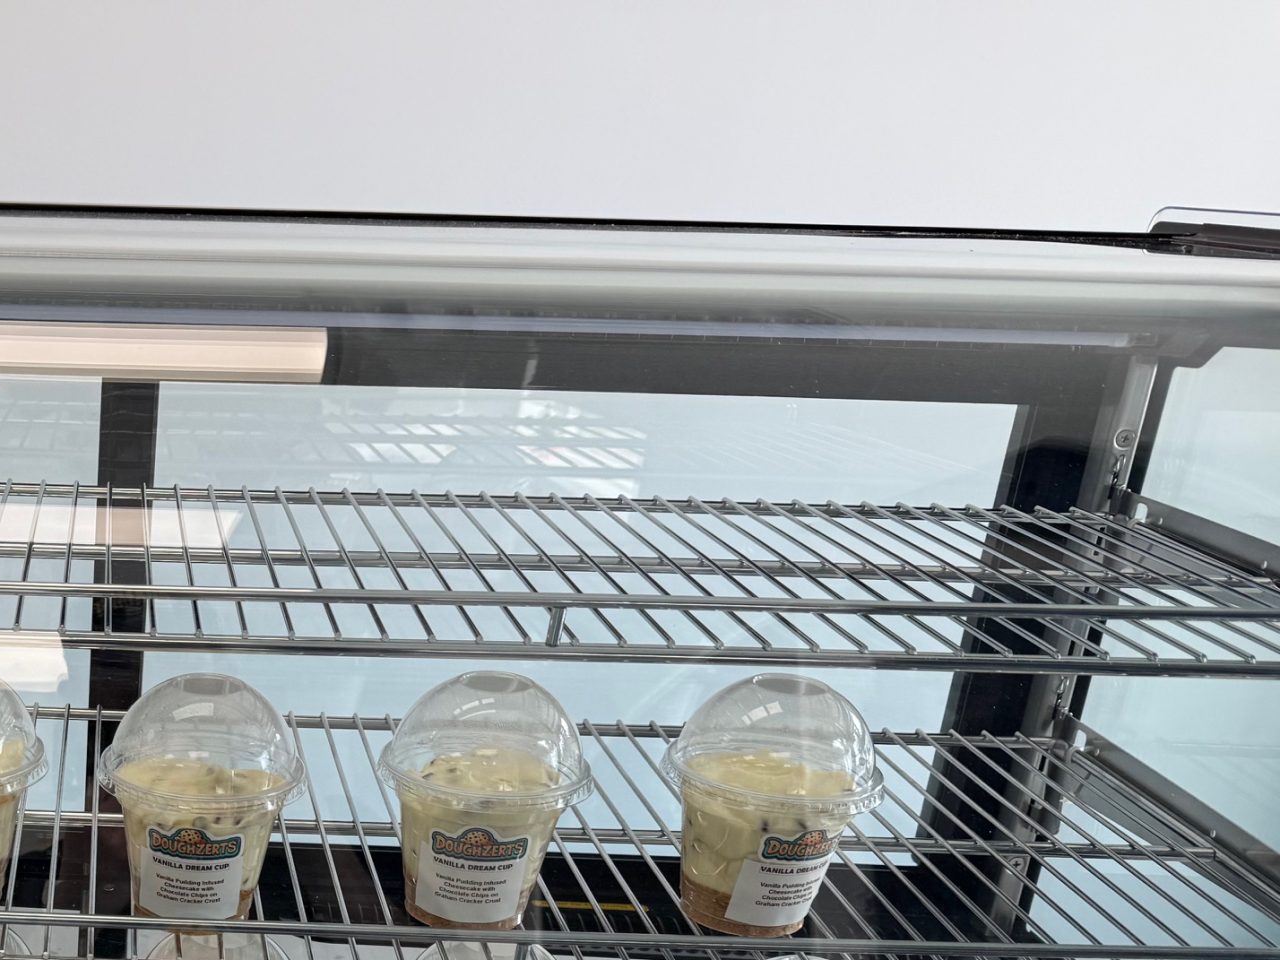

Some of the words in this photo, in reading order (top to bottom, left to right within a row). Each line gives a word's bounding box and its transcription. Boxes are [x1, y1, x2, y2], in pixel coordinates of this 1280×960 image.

[152, 832, 237, 856] DOUGHZERTS
[435, 835, 524, 857] DOUGHZERTS
[152, 856, 183, 870] VANILLA
[433, 856, 466, 870] VANILLA
[497, 863, 513, 871] CUP
[760, 866, 795, 875] VANILLA
[796, 865, 820, 873] DREAM
